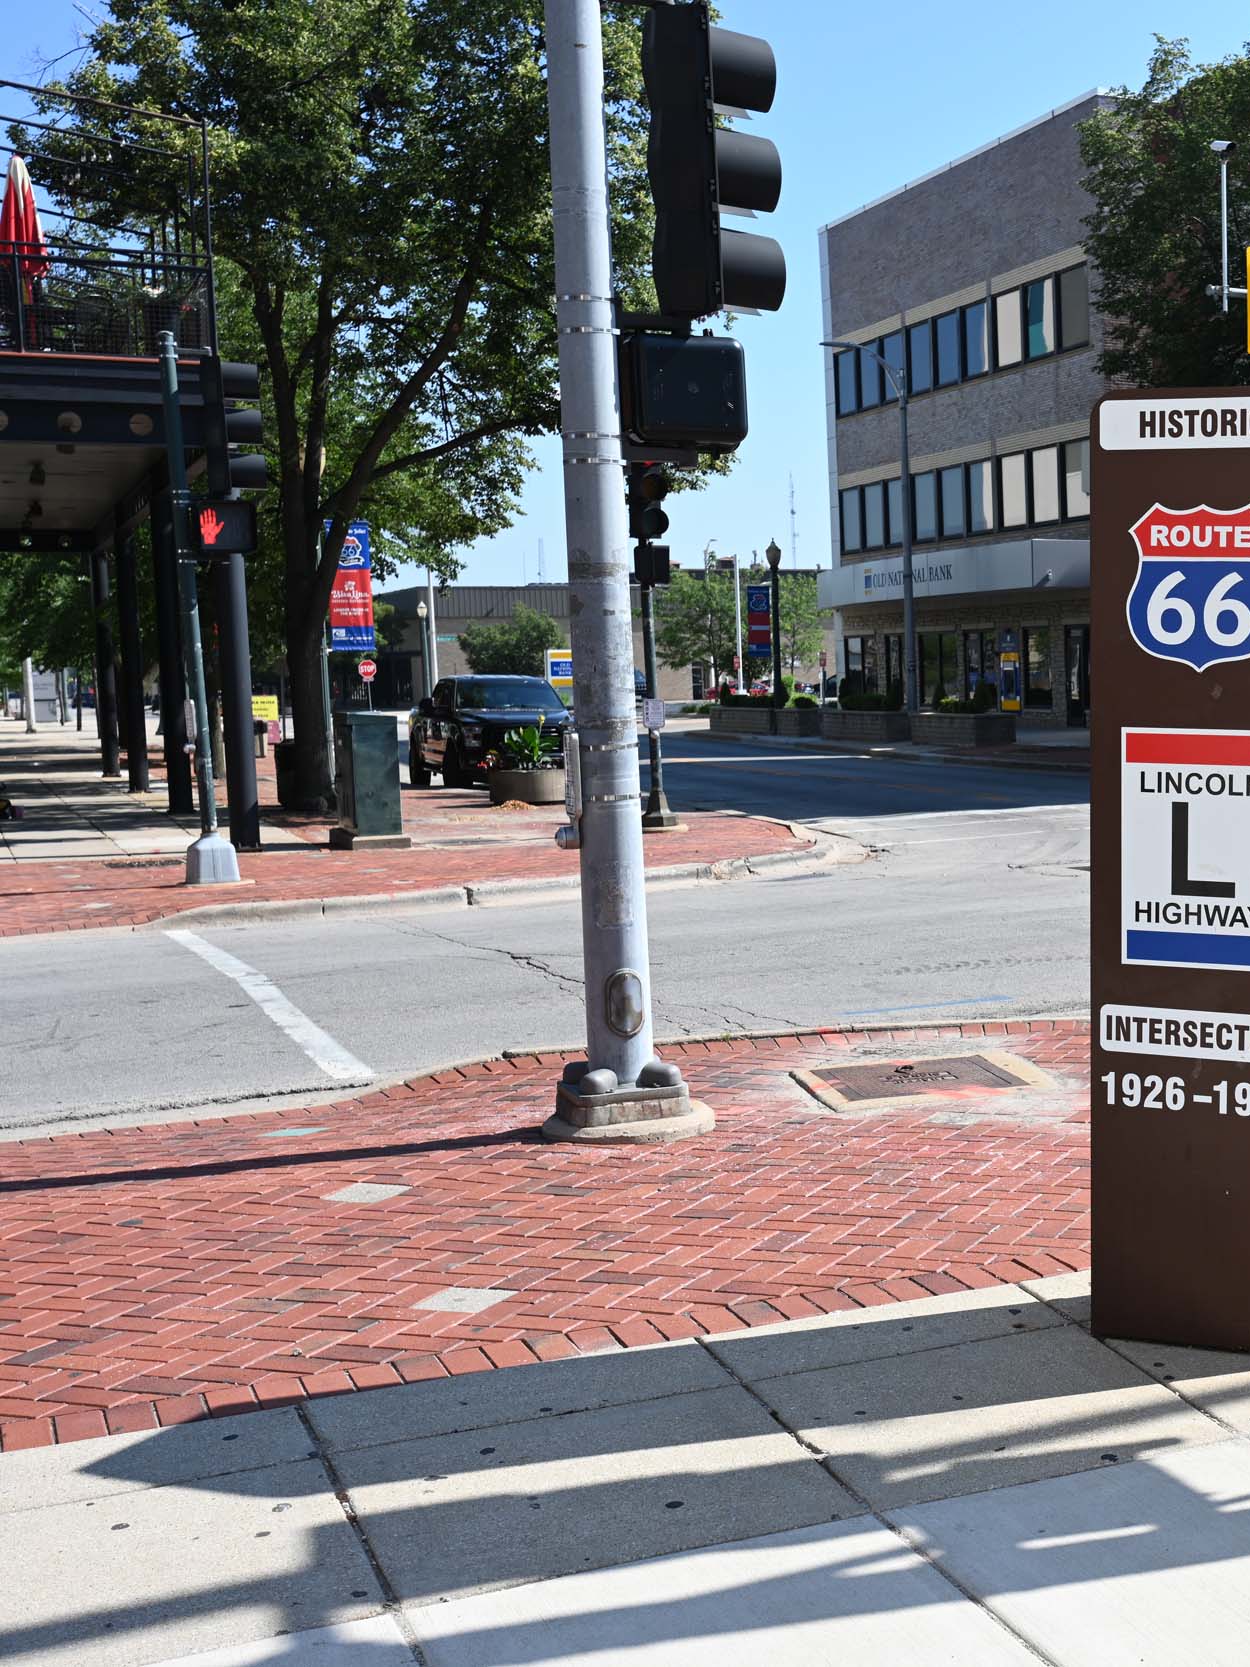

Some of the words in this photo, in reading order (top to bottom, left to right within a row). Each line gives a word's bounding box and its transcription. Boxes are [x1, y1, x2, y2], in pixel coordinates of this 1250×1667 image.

[872, 573, 887, 588] OLD
[929, 564, 953, 582] BANK
[360, 665, 375, 673] STOP
[1171, 801, 1236, 899] L
